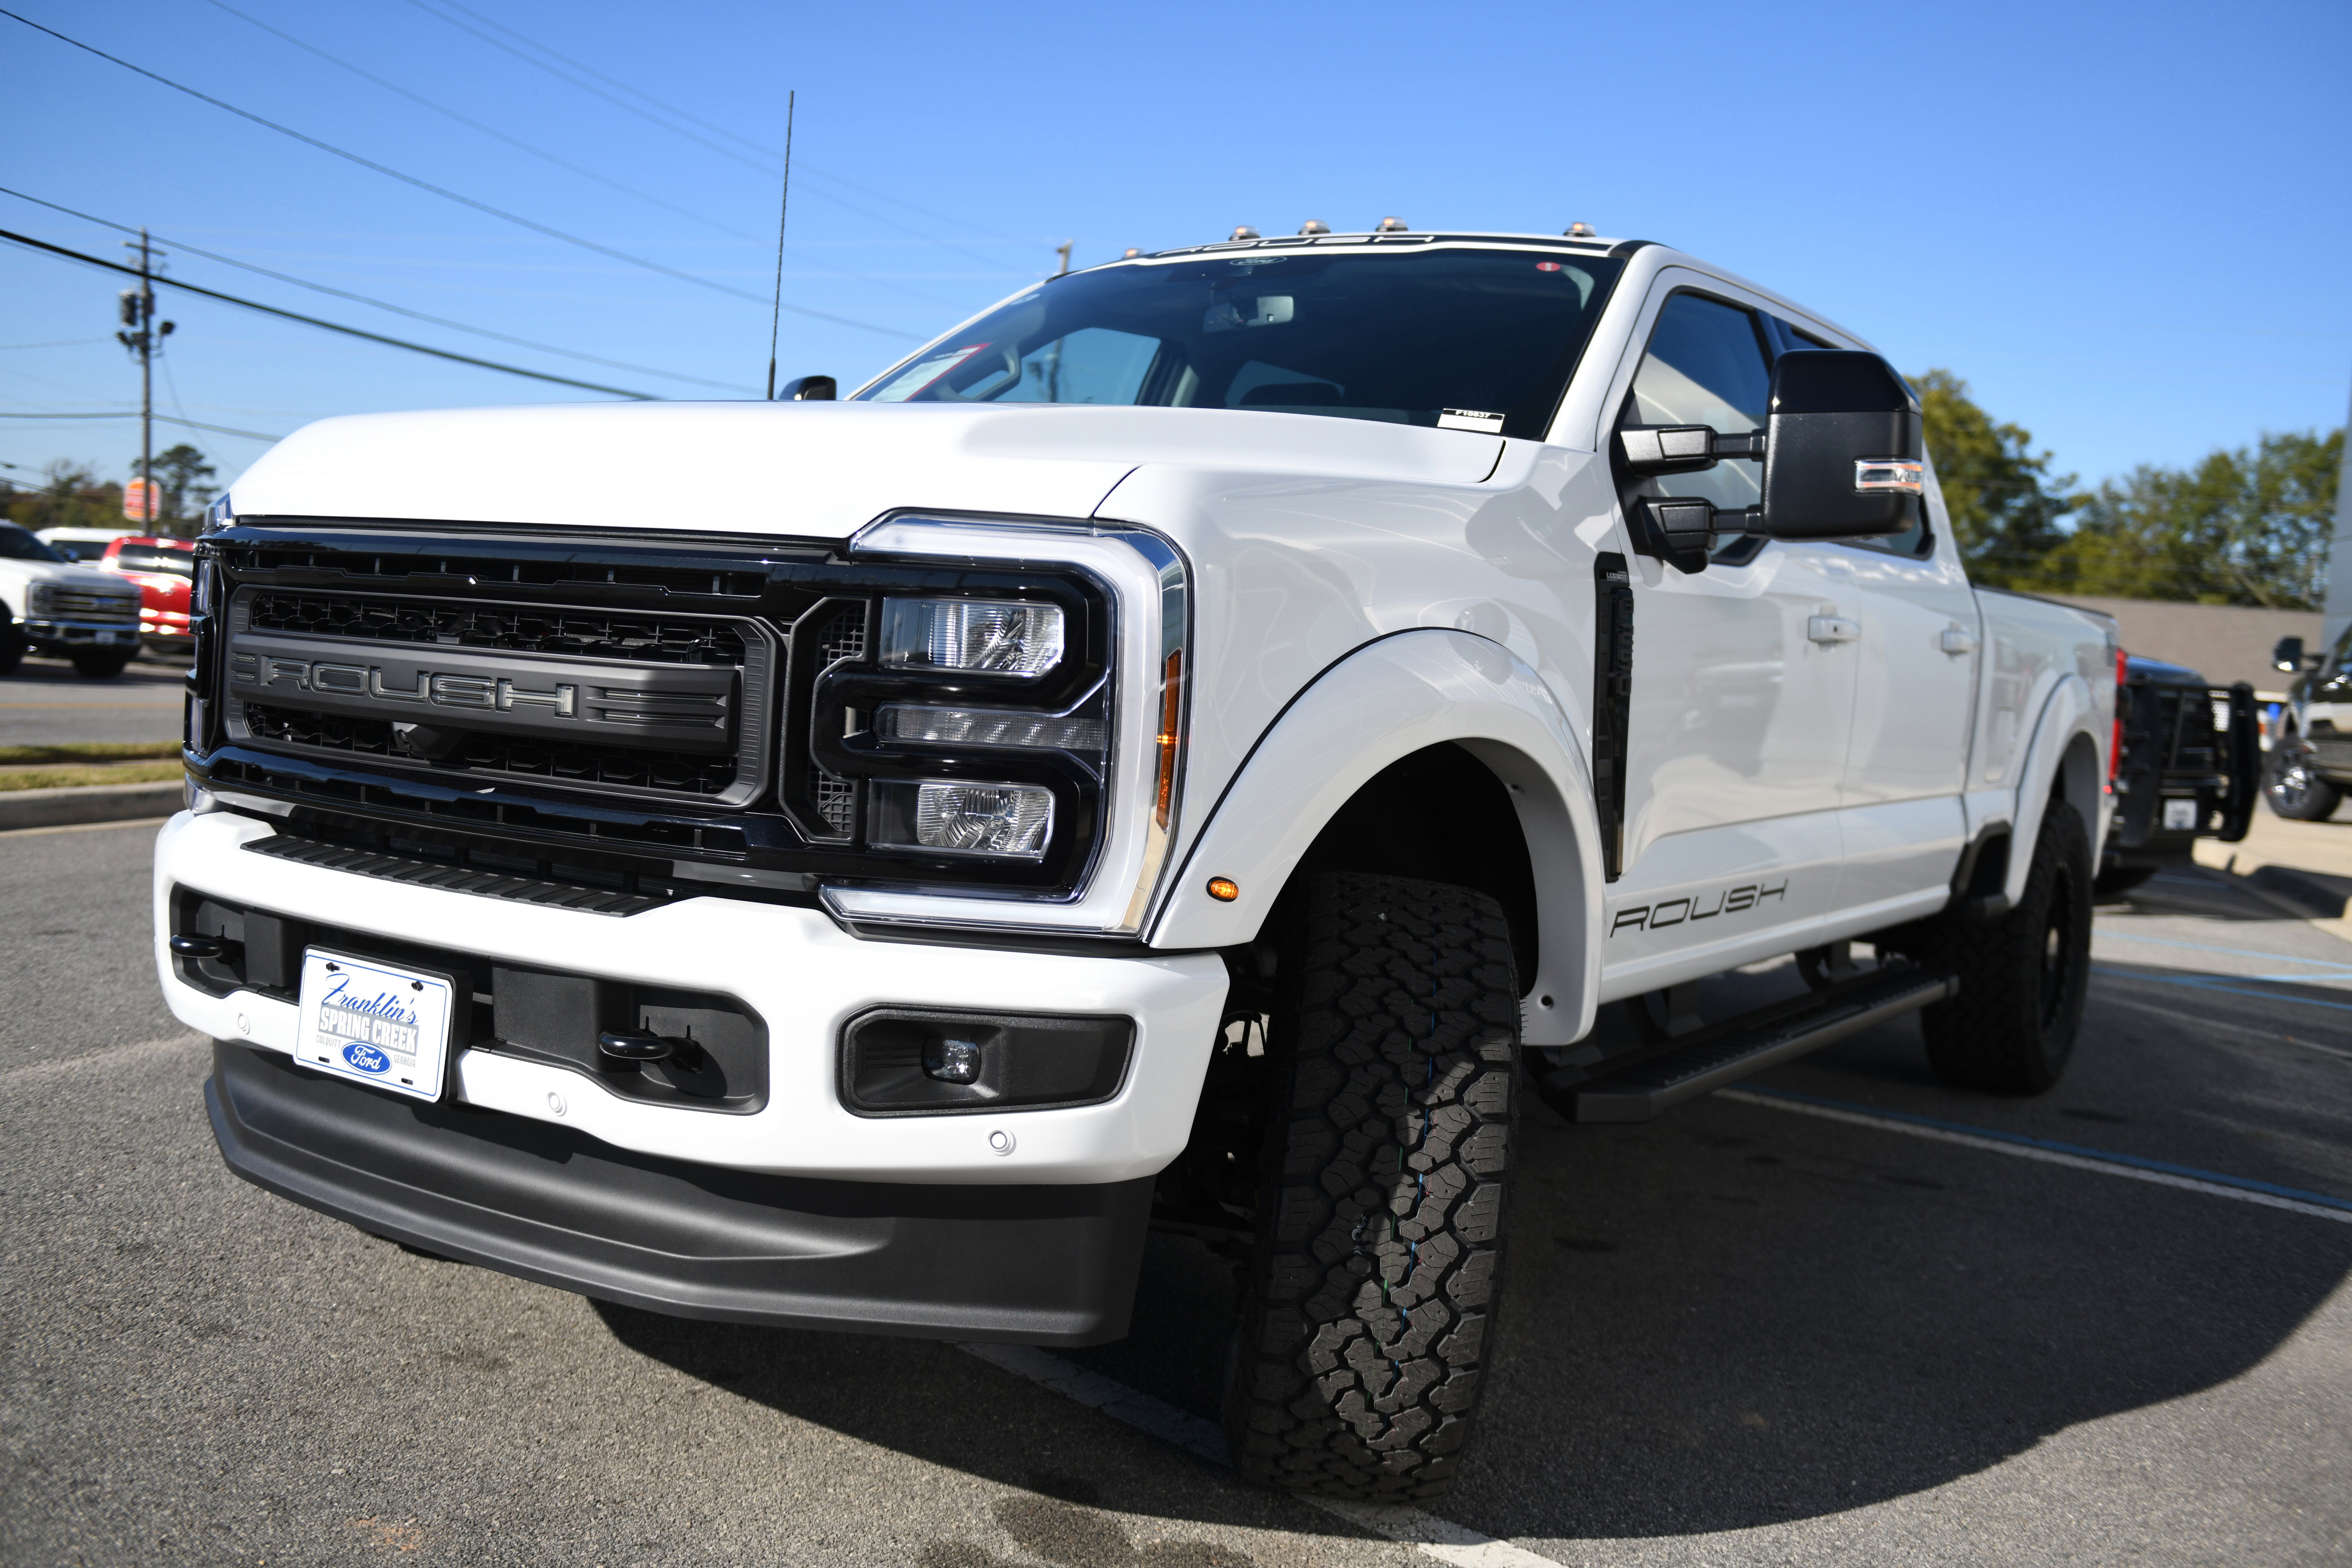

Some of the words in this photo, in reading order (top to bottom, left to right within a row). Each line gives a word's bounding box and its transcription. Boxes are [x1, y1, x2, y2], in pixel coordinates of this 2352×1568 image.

[1156, 236, 1434, 256] ROUSH
[1456, 410, 1491, 418] F10837
[1606, 572, 1627, 580] LARIAT
[261, 655, 577, 719] ROUSH
[1610, 878, 1788, 938] ROUSH
[322, 973, 419, 1024] Franklin's
[320, 1007, 370, 1041] SPRING
[372, 1020, 417, 1053] CREEK
[316, 1035, 341, 1048] COLQUITT
[351, 1045, 382, 1069] Ford
[394, 1054, 416, 1068] GEORGIA
